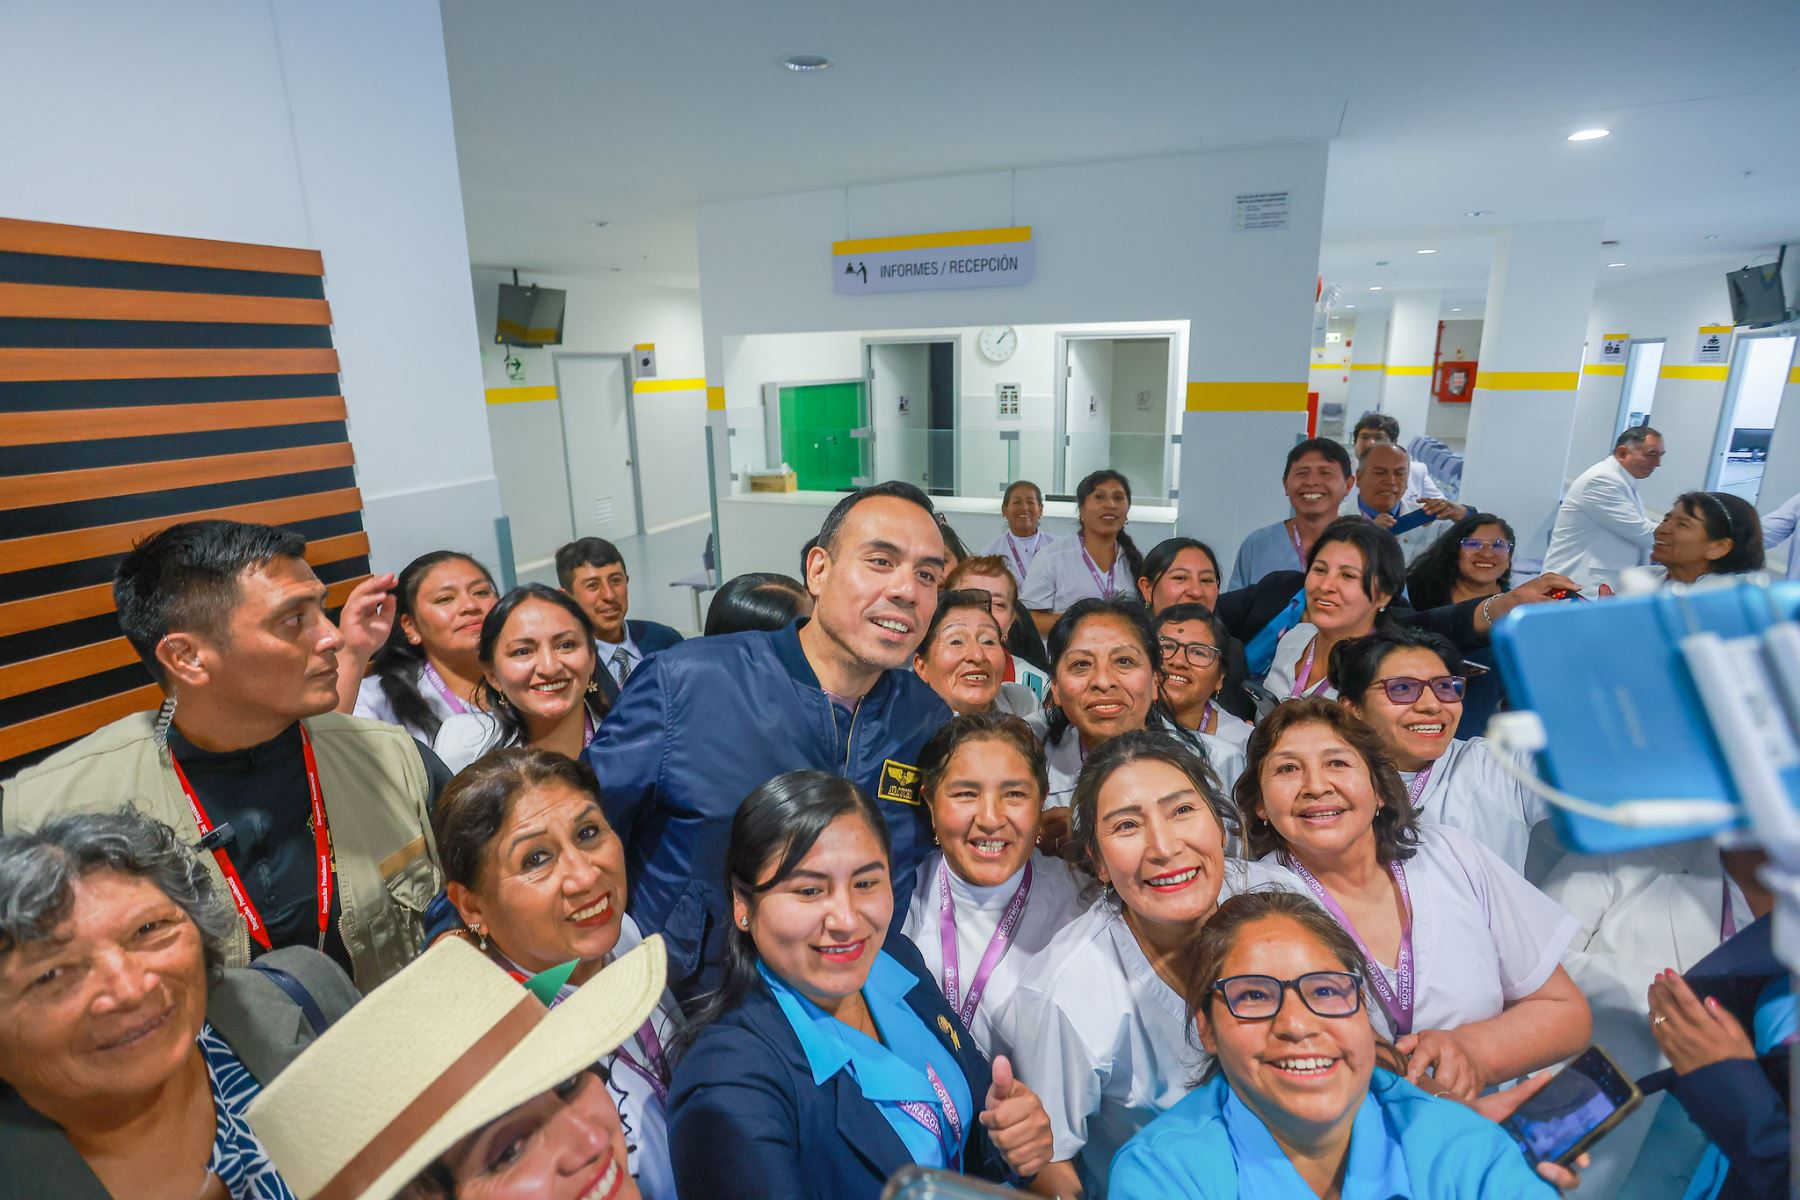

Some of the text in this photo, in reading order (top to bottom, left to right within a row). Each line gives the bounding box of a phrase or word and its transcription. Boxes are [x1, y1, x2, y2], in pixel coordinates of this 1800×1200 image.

[880, 254, 1018, 278] INFORMES / RECEPCIÓN
